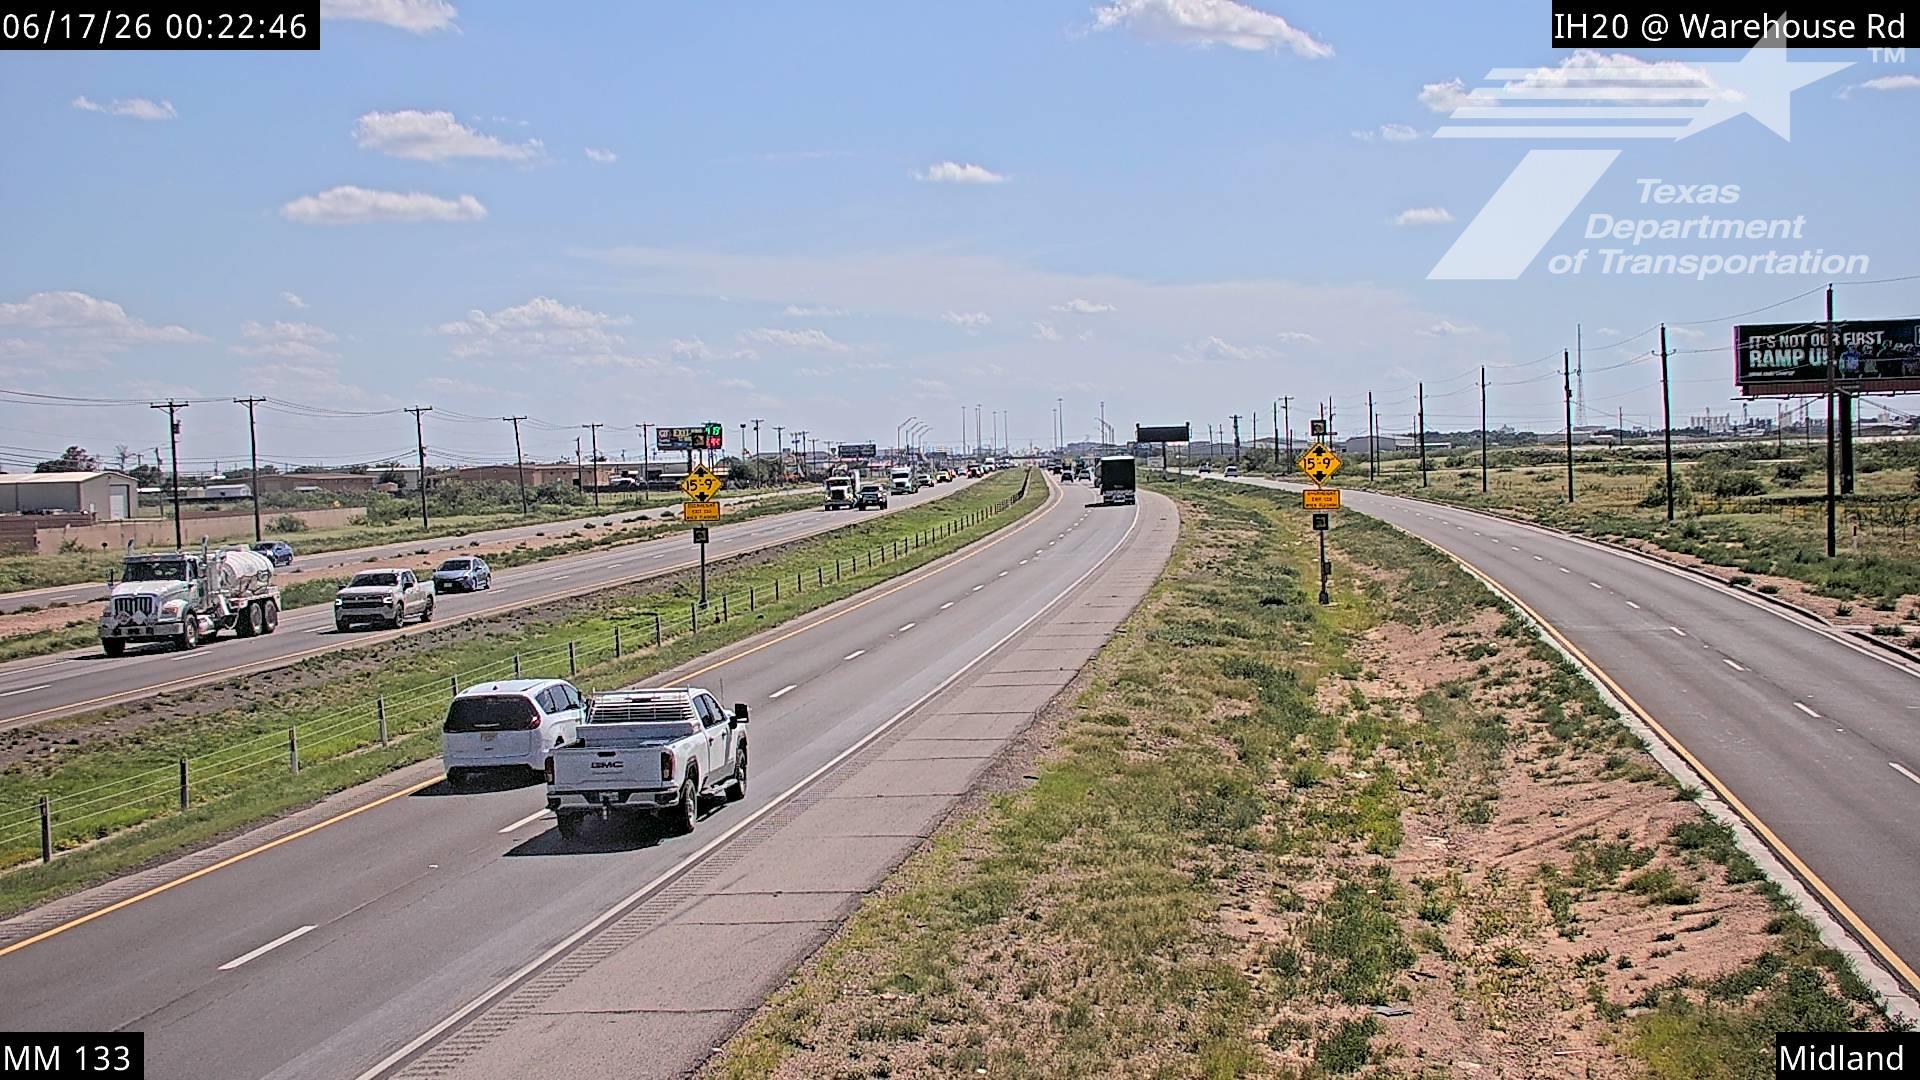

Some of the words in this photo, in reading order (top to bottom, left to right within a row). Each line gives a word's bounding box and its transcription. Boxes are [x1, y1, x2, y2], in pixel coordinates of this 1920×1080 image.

[1749, 335, 1776, 349] IT'S
[1779, 333, 1808, 349] NOT
[1843, 330, 1886, 346] FIRST
[1750, 348, 1806, 368] RAMP
[591, 761, 624, 769] GMC
